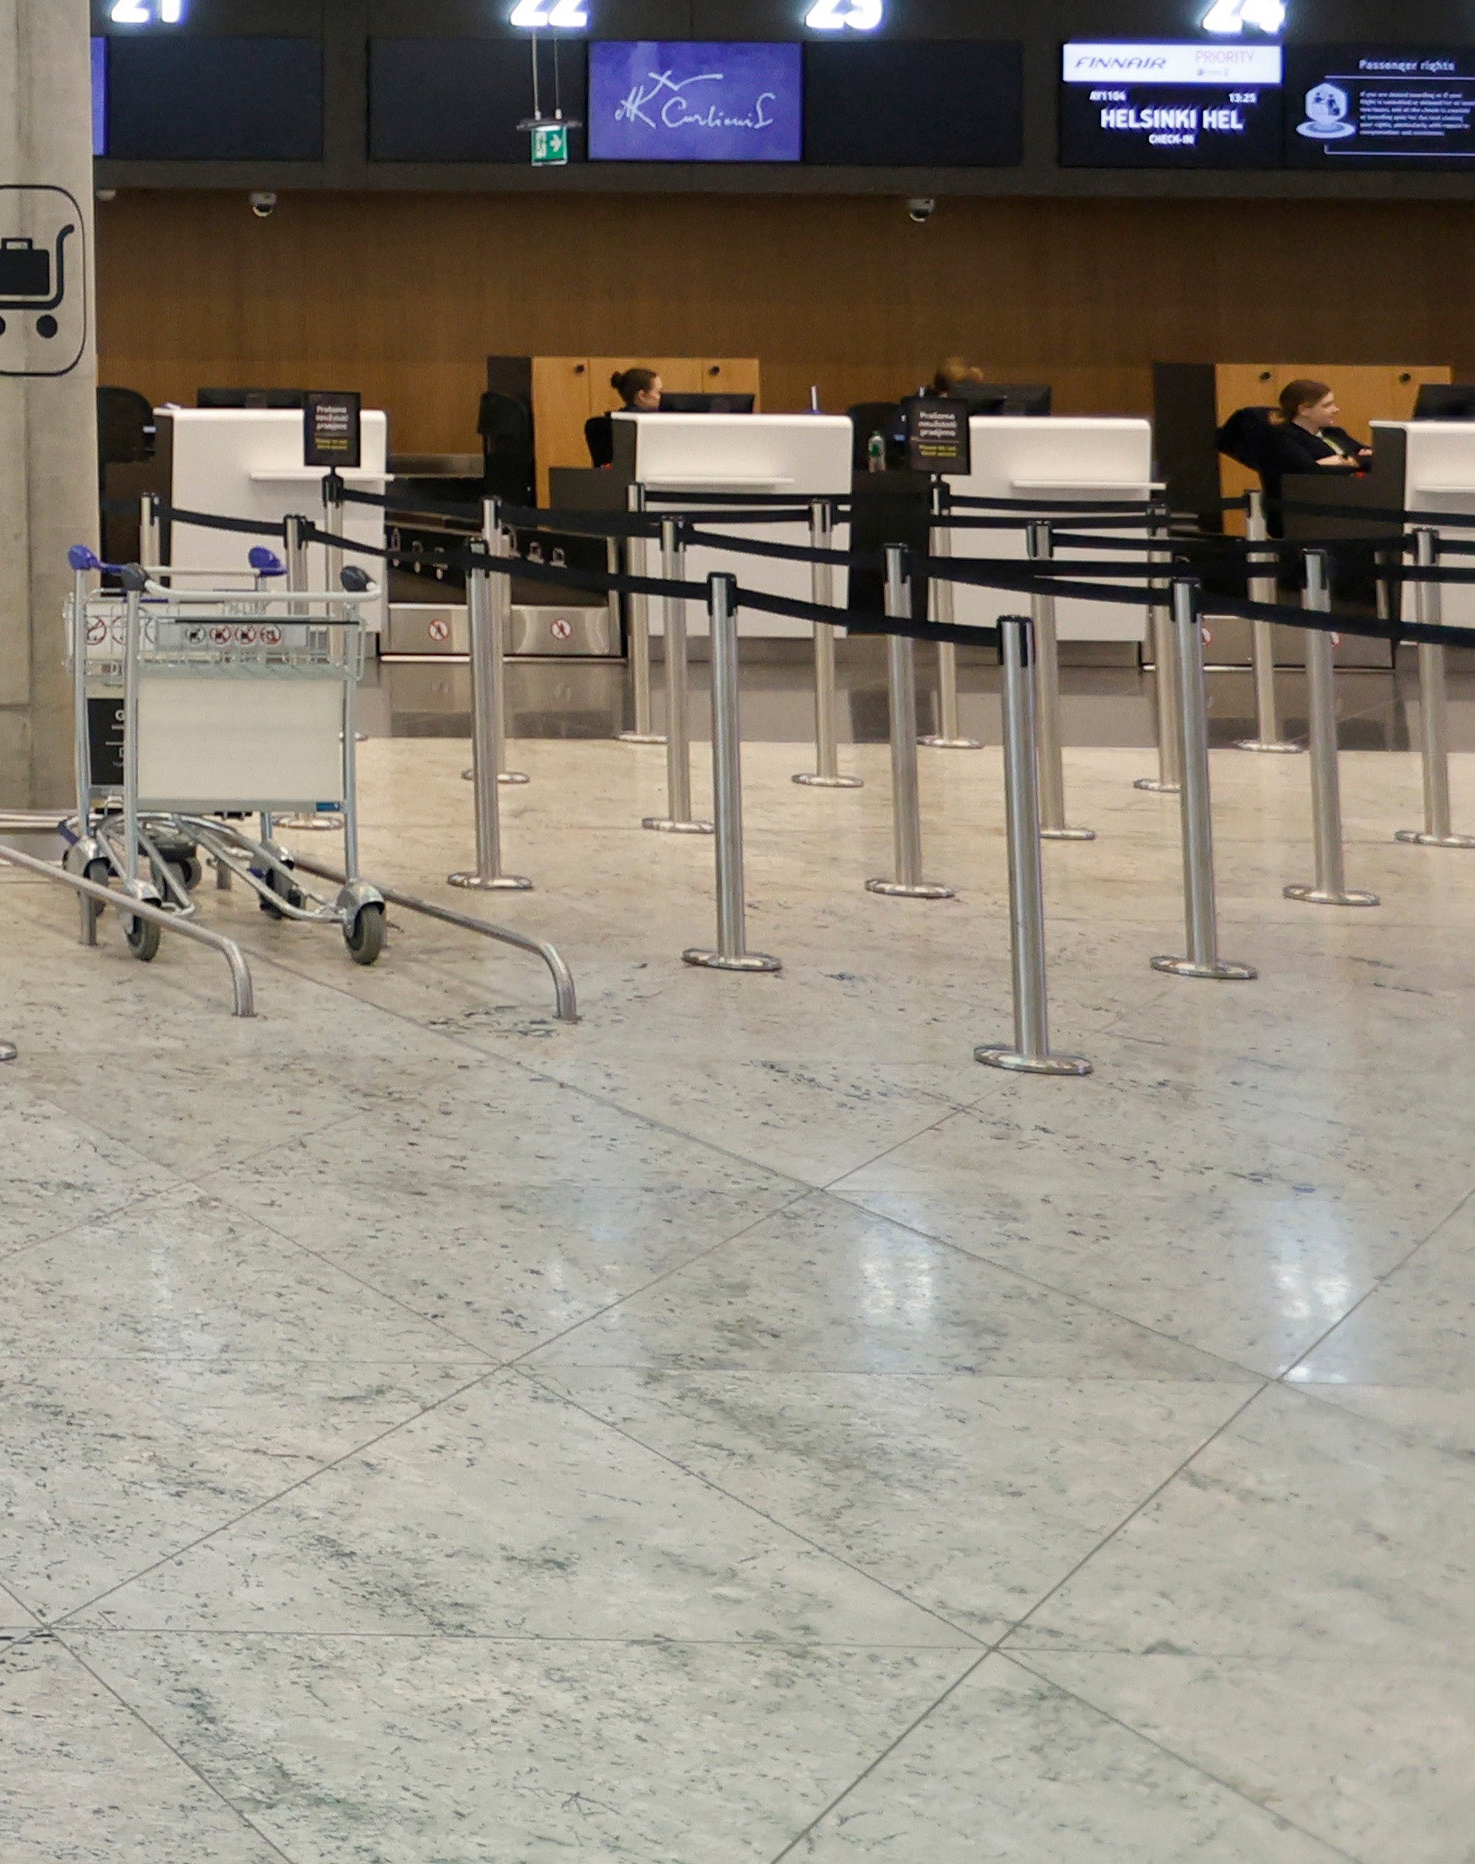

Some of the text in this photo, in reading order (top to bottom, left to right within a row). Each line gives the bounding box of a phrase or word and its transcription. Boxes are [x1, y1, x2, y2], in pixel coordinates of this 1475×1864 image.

[1075, 50, 1254, 69] FINNAIR PRIORITY
[1358, 59, 1455, 73] Passenger rights
[1228, 92, 1257, 104] 13:25
[1100, 108, 1244, 130] HELSINKI HEL
[1148, 134, 1195, 145] CHECK-IN
